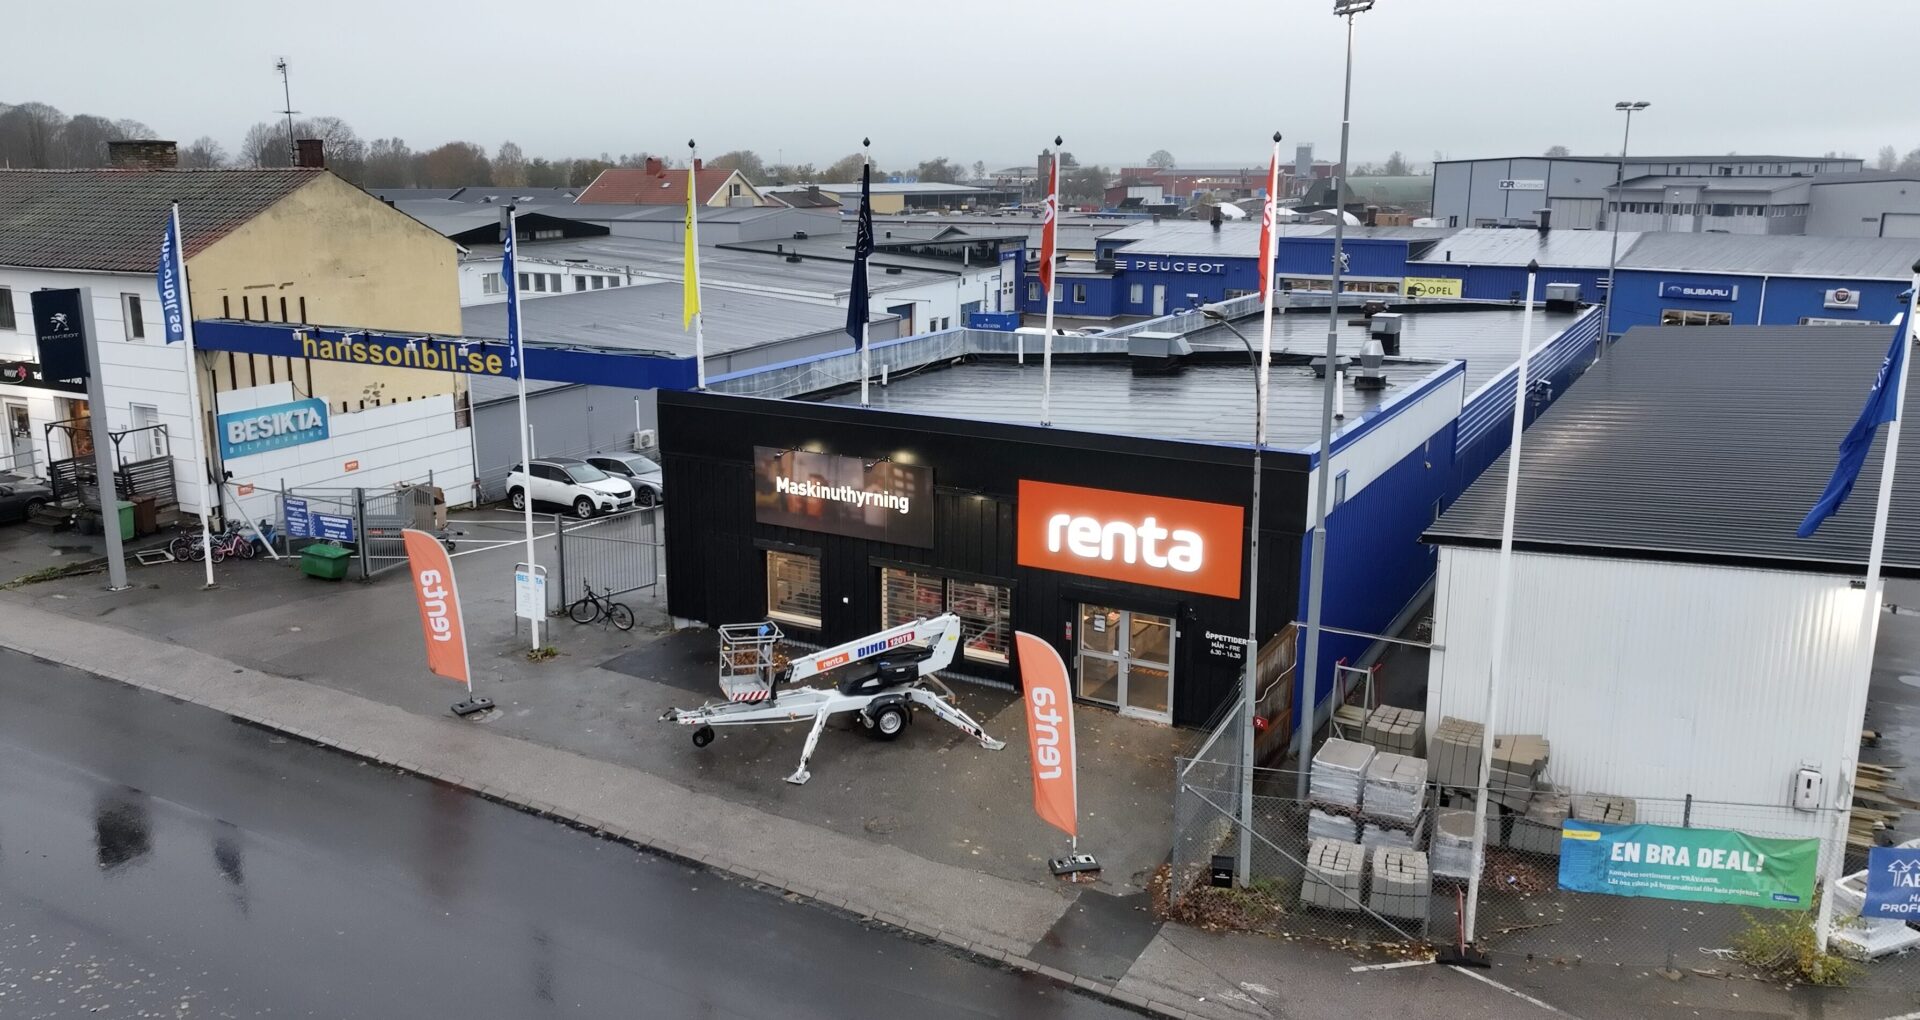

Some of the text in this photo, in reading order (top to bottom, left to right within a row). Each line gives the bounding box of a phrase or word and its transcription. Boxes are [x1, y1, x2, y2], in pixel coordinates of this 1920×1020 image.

[1136, 260, 1225, 273] PEUGEOT
[1428, 286, 1453, 295] OPEL
[1683, 287, 1729, 297] SUBARU
[42, 332, 79, 340] PEUGEOT
[302, 332, 503, 374] hanssonbil.se
[227, 407, 323, 444] BESIKTA
[229, 429, 323, 454] BILPROVNING
[776, 476, 910, 515] Maskinuthyrning
[1048, 514, 1203, 573] renta
[857, 632, 912, 658] DINO 120TB
[823, 656, 845, 668] renta
[1611, 842, 1765, 873] EN BRA DEAL!
